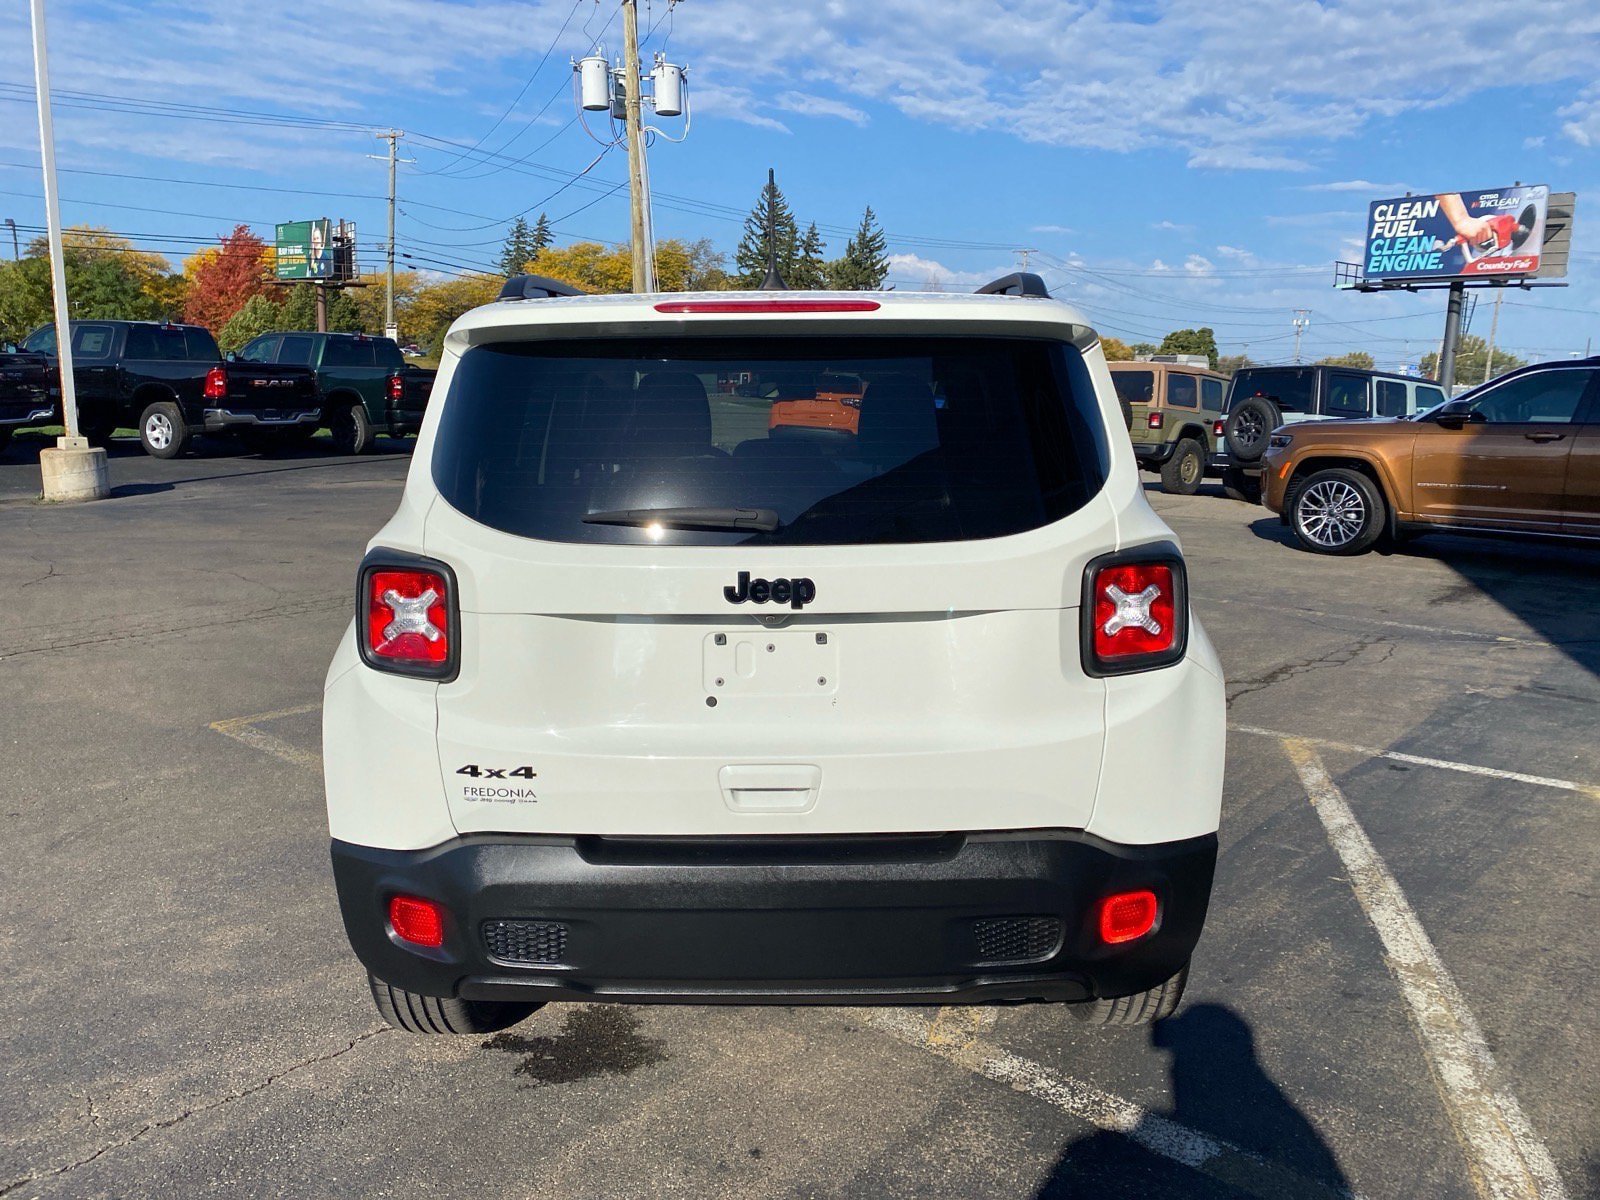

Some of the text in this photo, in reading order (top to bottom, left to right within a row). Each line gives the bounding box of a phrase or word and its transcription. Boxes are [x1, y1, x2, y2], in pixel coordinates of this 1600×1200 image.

[1374, 200, 1440, 222] CLEAN
[1370, 219, 1425, 239] FUEL.
[1370, 235, 1436, 256] CLEAN
[1367, 252, 1444, 273] ENGINE.
[1476, 259, 1533, 271] Country Fair
[723, 571, 816, 610] Jeep
[455, 764, 537, 779] 4x4
[463, 786, 537, 798] FREDONIA
